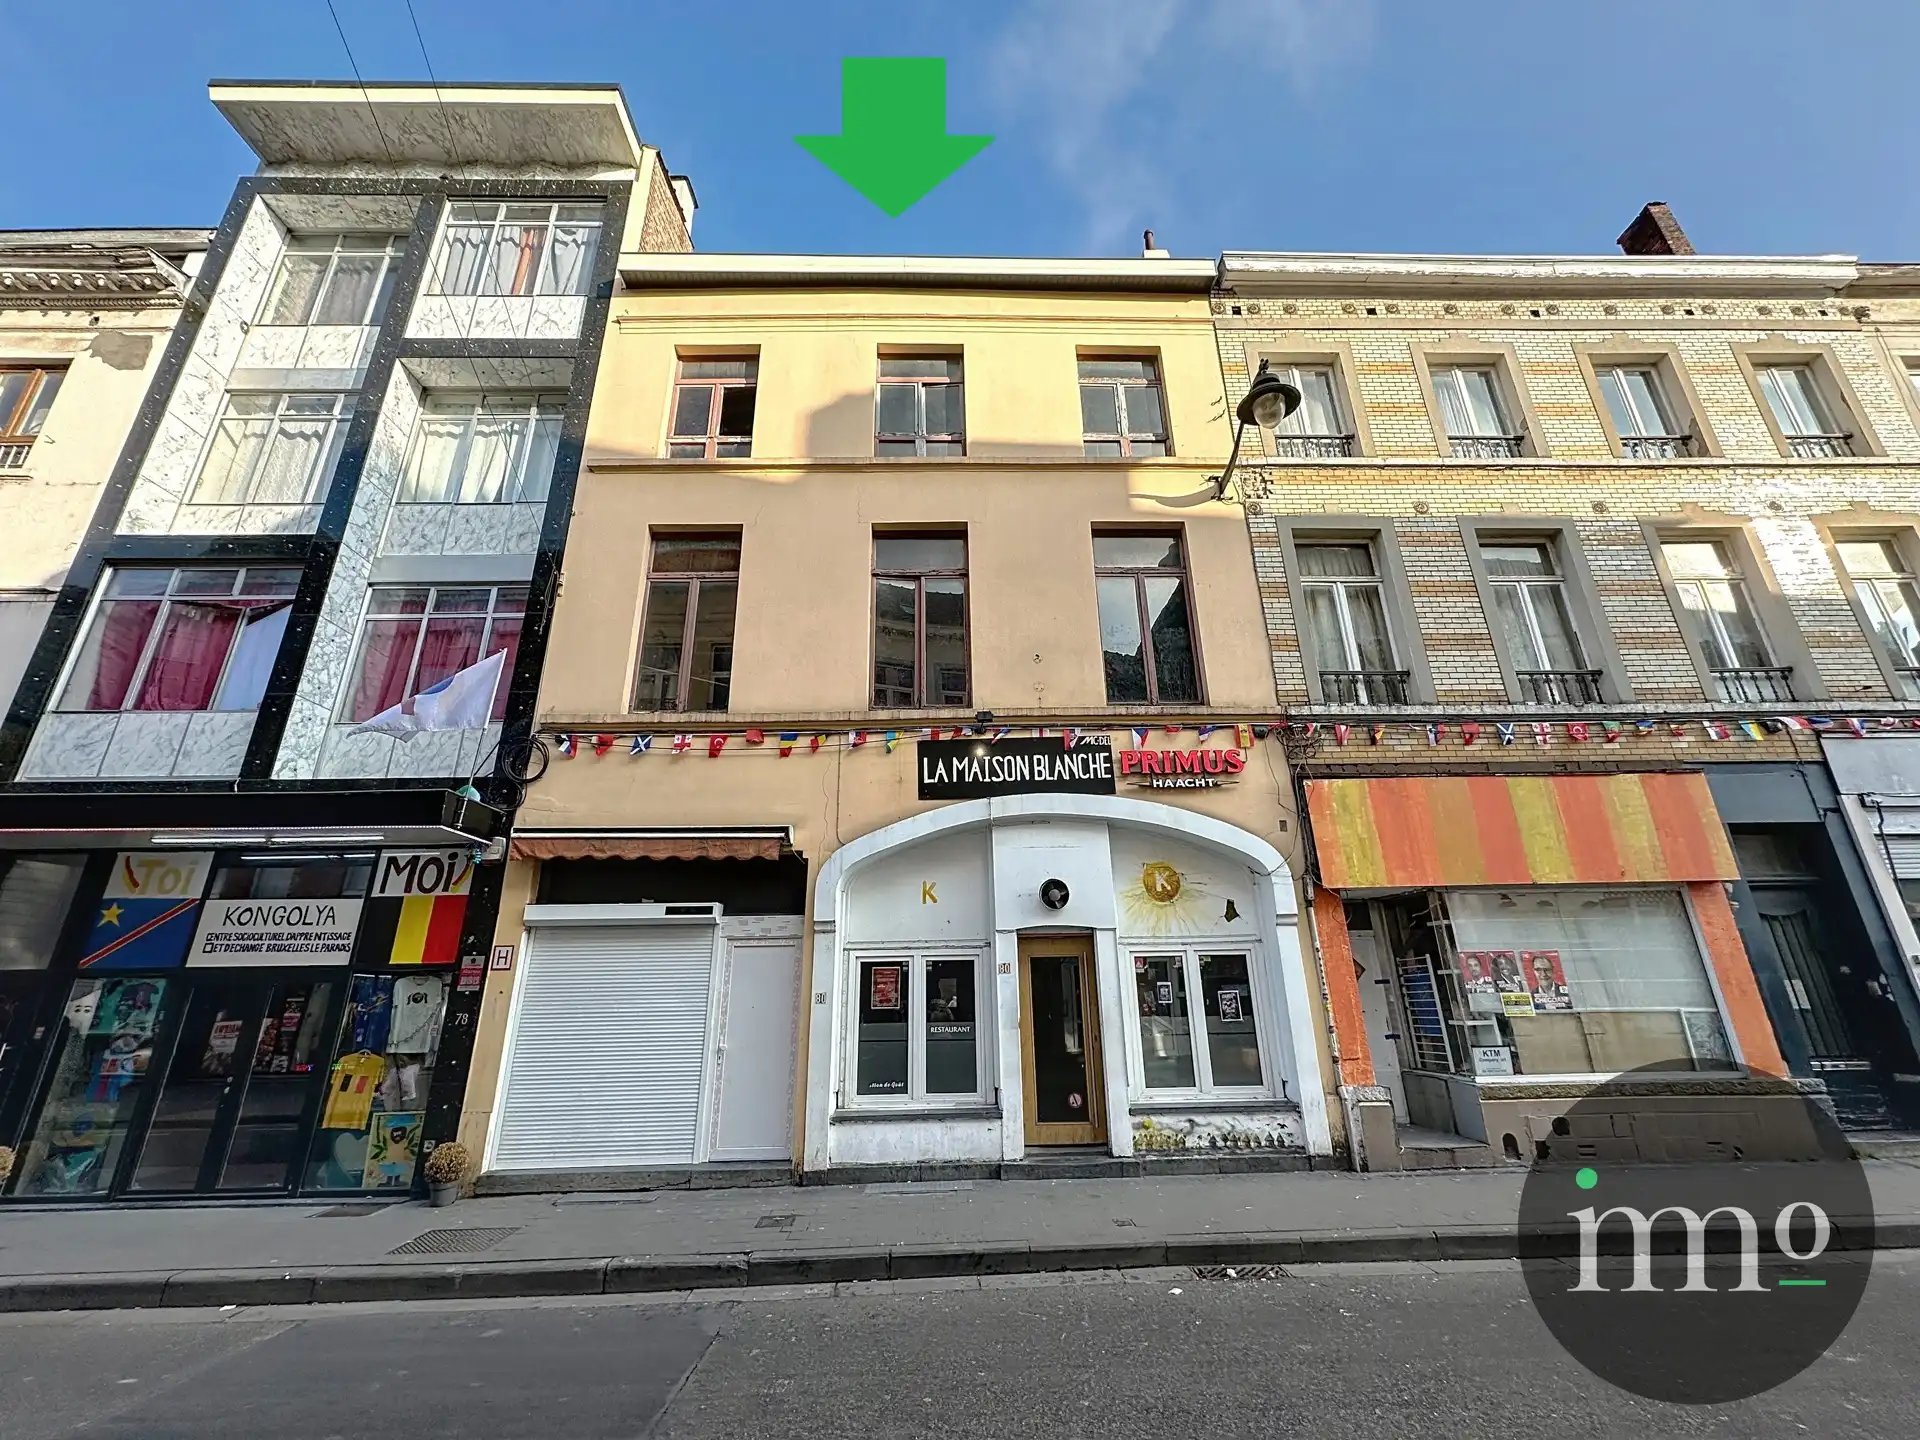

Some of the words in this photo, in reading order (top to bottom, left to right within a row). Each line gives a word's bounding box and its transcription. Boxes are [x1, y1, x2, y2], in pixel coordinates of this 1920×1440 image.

[923, 756, 949, 784] LA
[952, 755, 1030, 783] MAISON
[1033, 752, 1112, 781] BLANCHE
[1119, 748, 1246, 775] PRIMUS
[1152, 778, 1215, 788] HAACHT
[136, 857, 199, 895] Toi
[1155, 870, 1171, 892] K
[922, 880, 938, 905] K
[222, 904, 336, 927] KONGOLYA
[205, 932, 233, 942] CENTRE
[265, 943, 310, 953] BRUXELLES
[309, 943, 321, 952] LE
[455, 1013, 469, 1025] 78
[1482, 1049, 1501, 1057] KTM
